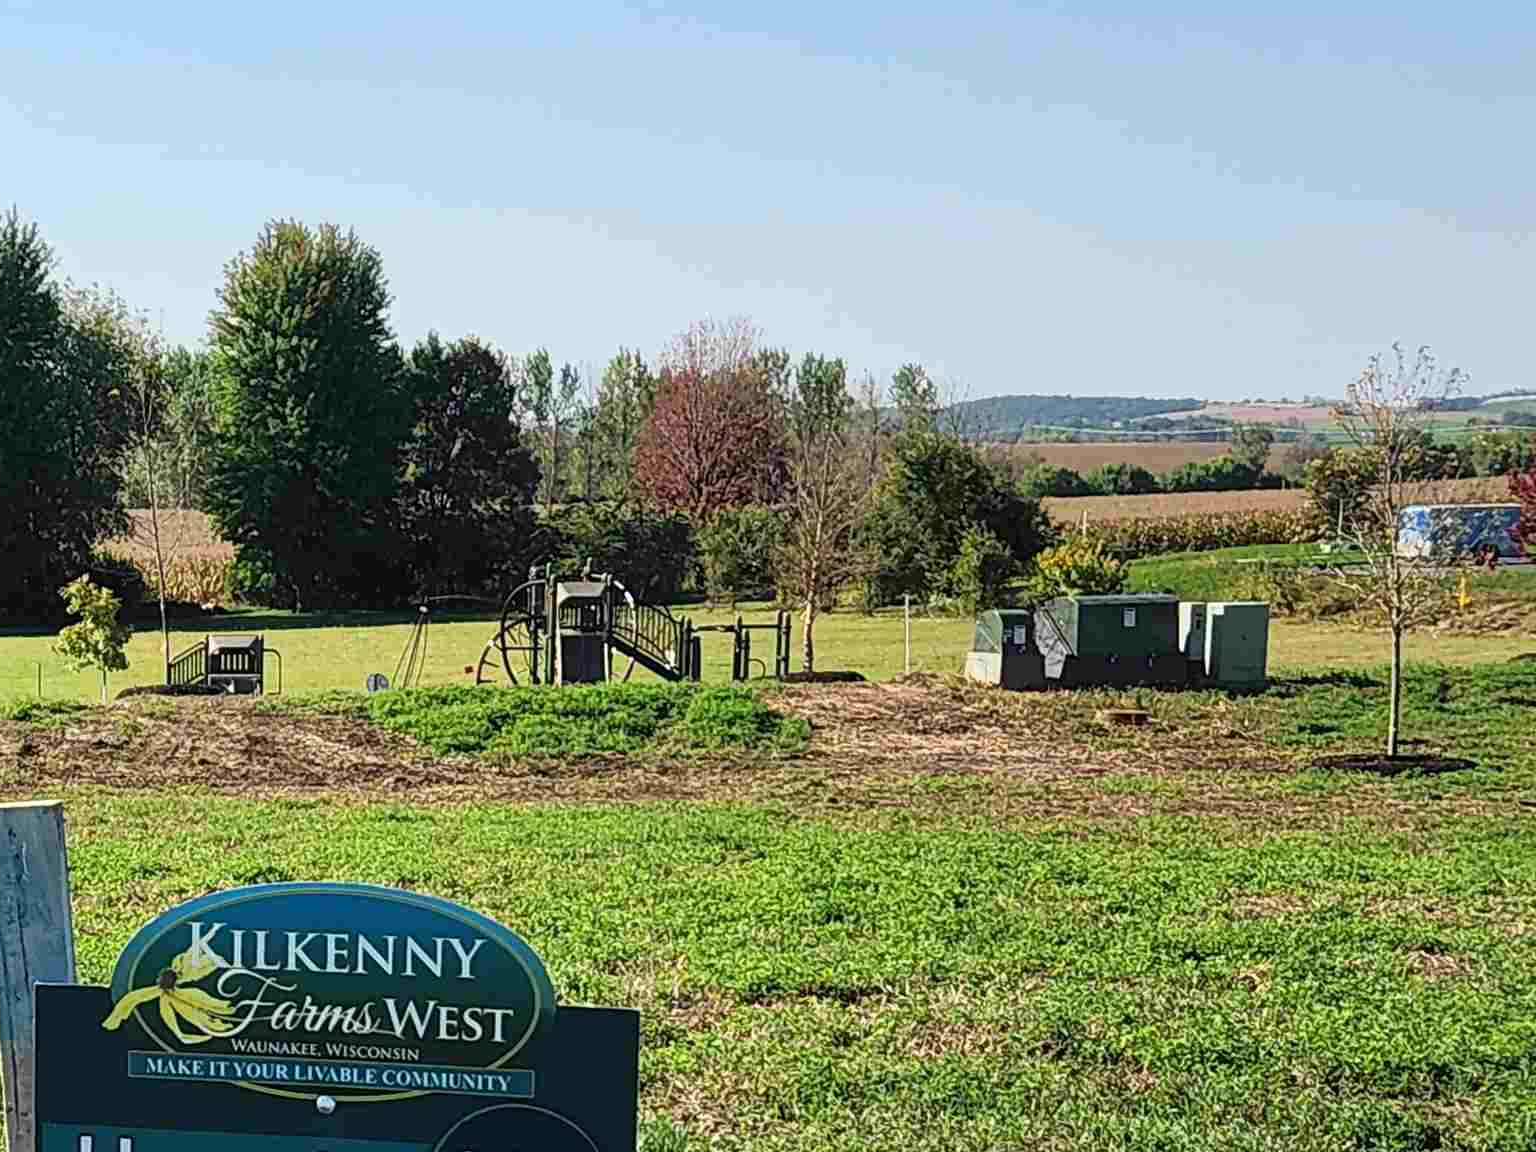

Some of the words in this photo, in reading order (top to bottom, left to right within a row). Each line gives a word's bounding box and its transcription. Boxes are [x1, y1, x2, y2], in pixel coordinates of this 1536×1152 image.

[188, 921, 488, 979] KILKENNY
[200, 967, 383, 1037] Farms
[383, 998, 514, 1043] WEST
[230, 1037, 322, 1058] WAUNAKEE,
[326, 1042, 420, 1061] WISCONSIN
[145, 1056, 205, 1076] MAKE
[209, 1060, 230, 1077] IT
[233, 1061, 290, 1081] YOUR
[293, 1064, 378, 1084] LIVABLE
[381, 1069, 513, 1092] COMMUNITY
